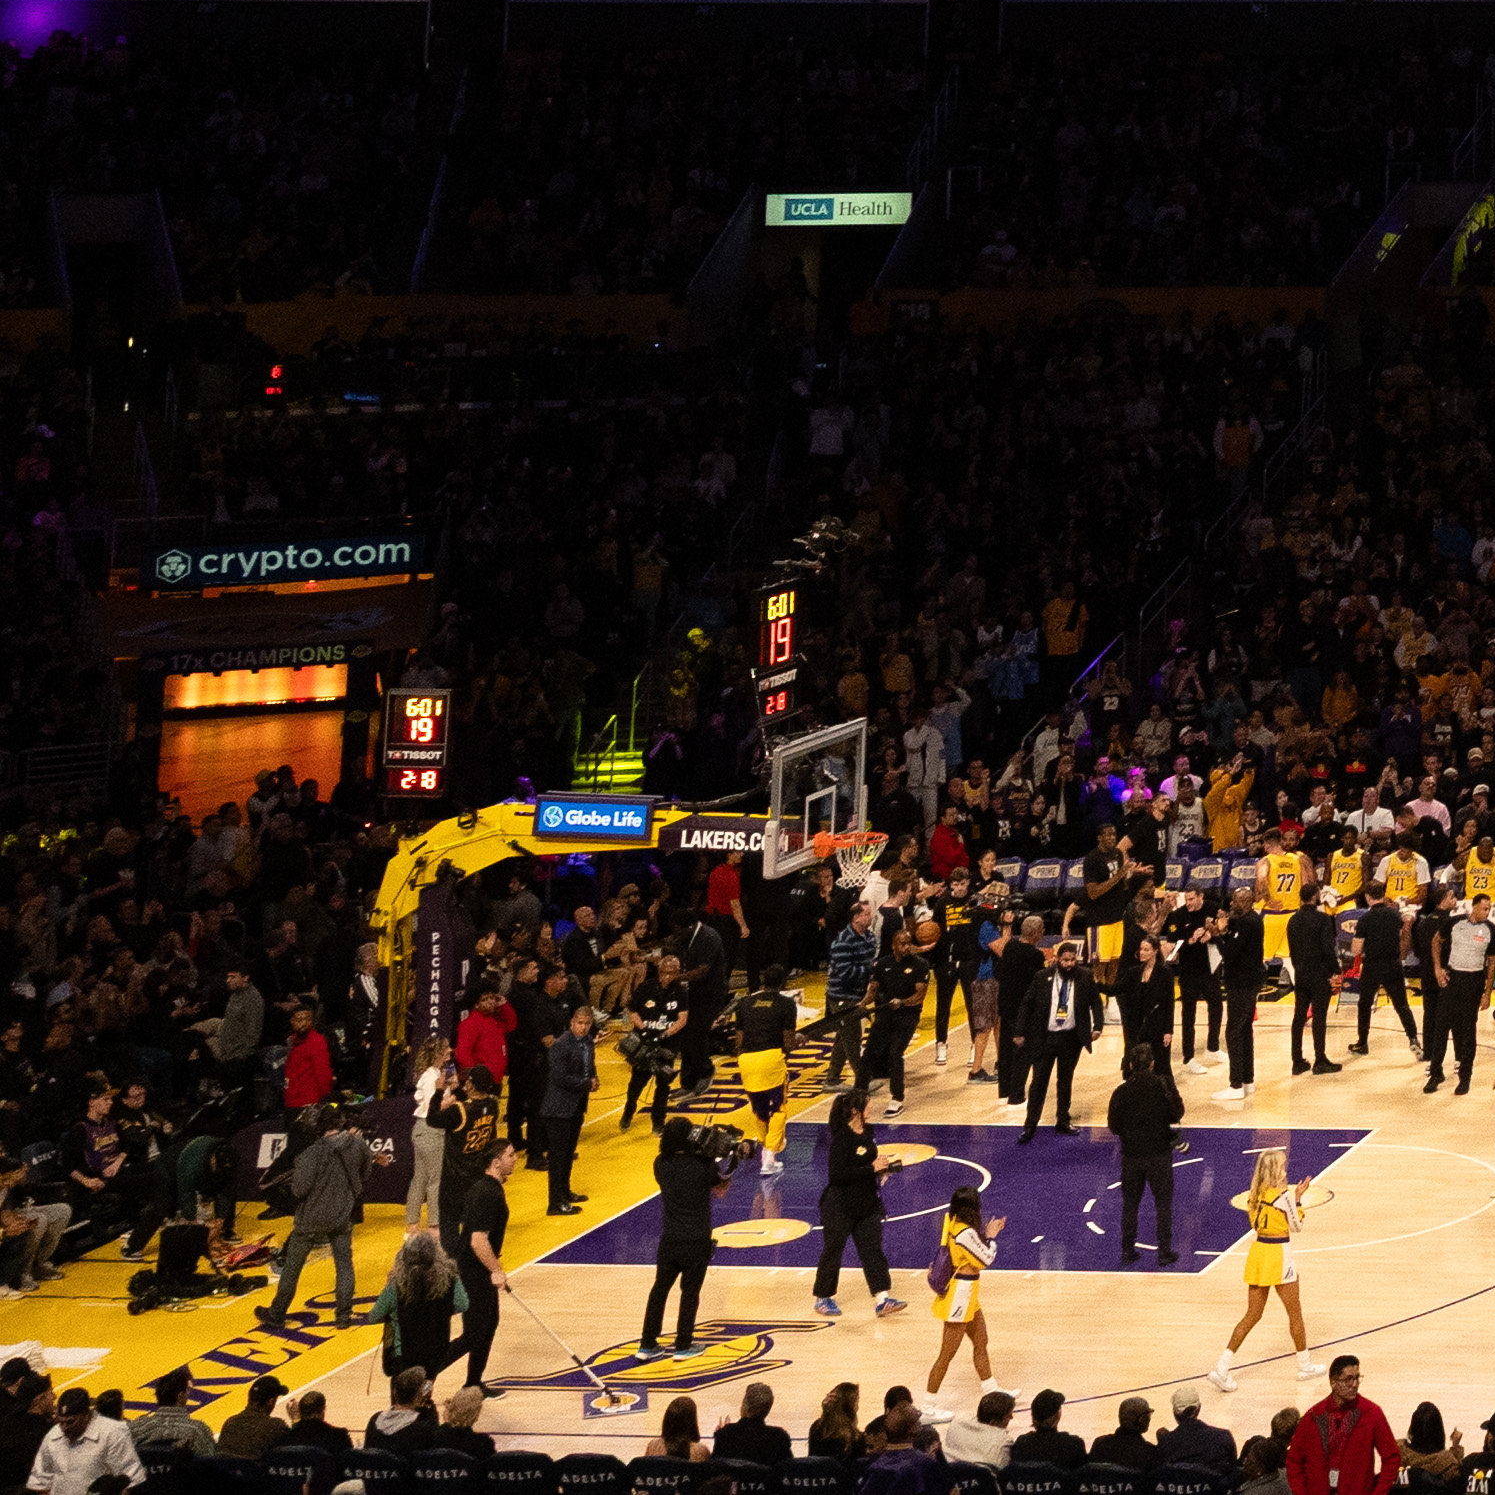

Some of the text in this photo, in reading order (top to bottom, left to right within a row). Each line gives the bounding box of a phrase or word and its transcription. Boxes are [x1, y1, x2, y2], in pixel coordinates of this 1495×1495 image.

[788, 200, 894, 218] UCLA Health
[198, 541, 411, 578] crypto.com
[769, 617, 792, 665] 19
[208, 643, 347, 668] CHAMPIONS
[405, 696, 443, 718] 6:01
[410, 717, 434, 743] 19
[565, 807, 643, 830] Globe Life
[1276, 873, 1296, 893] 77
[1336, 871, 1351, 884] 17
[1394, 877, 1406, 891] 11
[1472, 875, 1489, 890] 23
[277, 1466, 313, 1477] DELT
[424, 1468, 468, 1480] DELTA
[499, 1469, 543, 1481] DELTA
[572, 1472, 616, 1484] DELTA
[646, 1474, 691, 1487] DELTA
[793, 1476, 838, 1488] DELTA
[1016, 1481, 1061, 1493] DELTA
[1091, 1482, 1134, 1494] DELTA
[1166, 1482, 1211, 1494] DELTA
